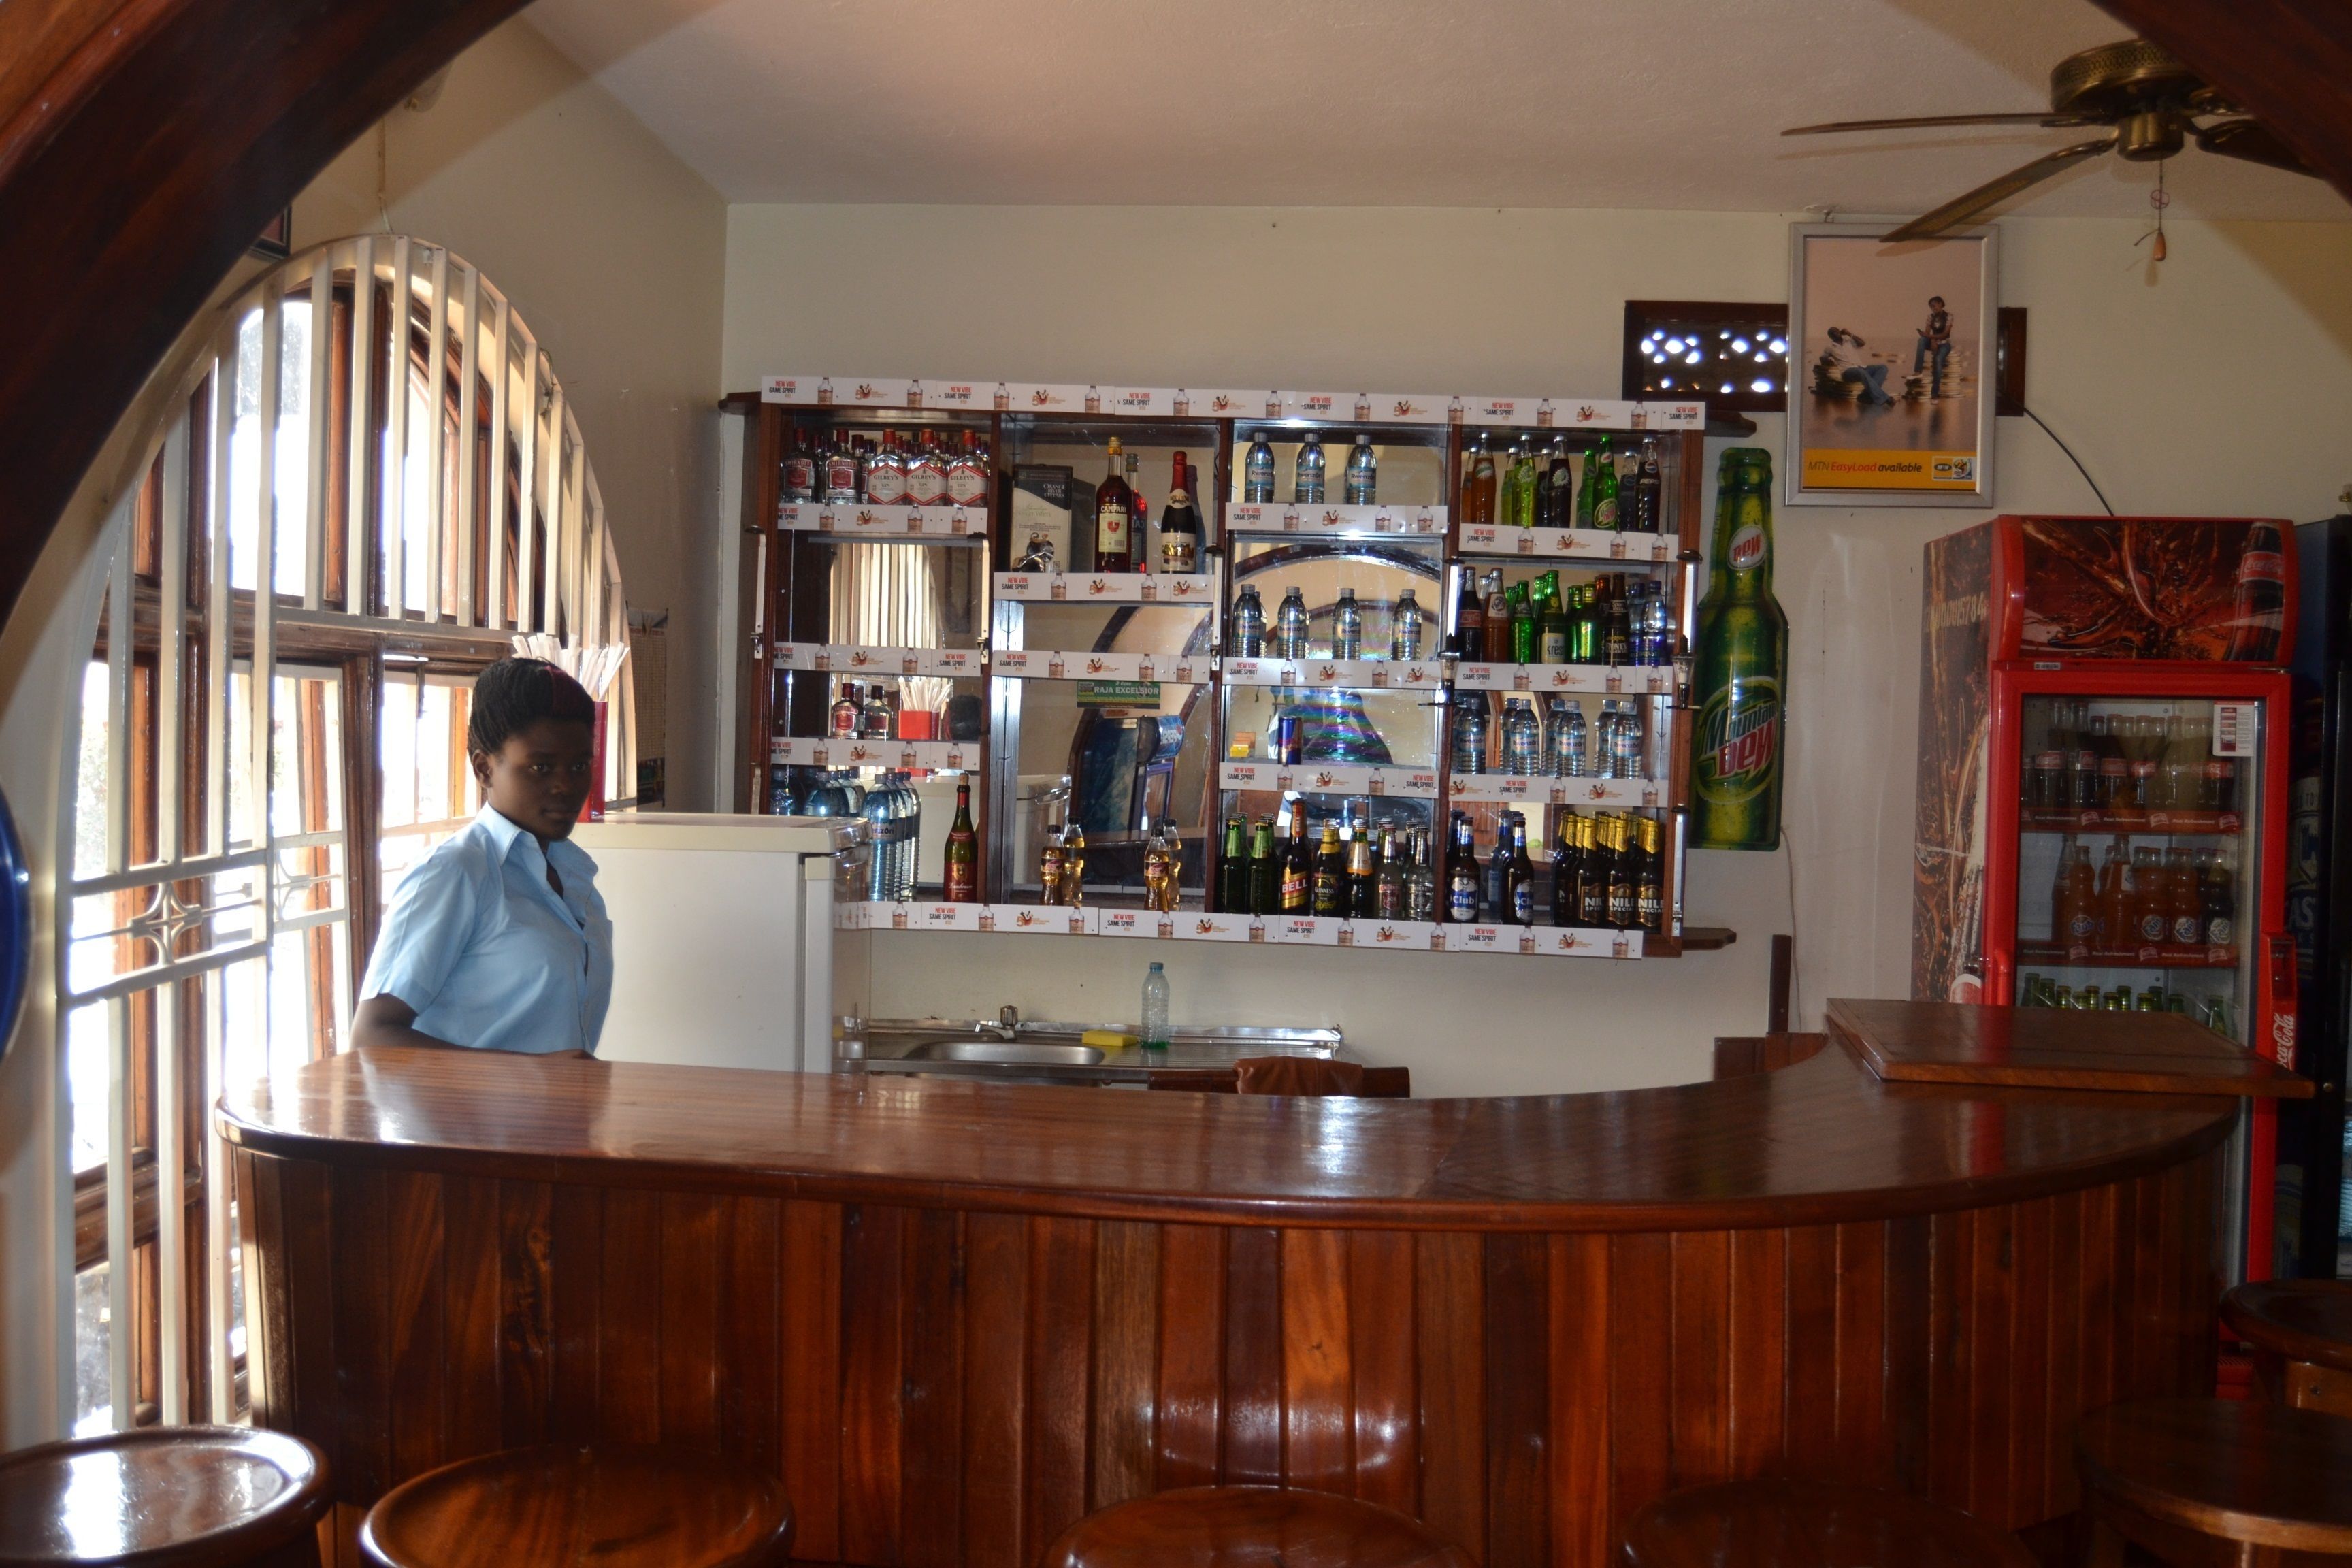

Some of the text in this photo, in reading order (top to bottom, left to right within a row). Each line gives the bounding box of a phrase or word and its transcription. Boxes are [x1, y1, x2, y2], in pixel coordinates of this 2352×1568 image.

[1808, 461, 1922, 474] MTN EasyLoad available
[1100, 506, 1127, 514] CAMPARI
[1115, 686, 1159, 695] EXCELSIOR
[1705, 701, 1777, 755] Mountain
[1282, 879, 1308, 894] BELL
[1453, 896, 1475, 904] Club
